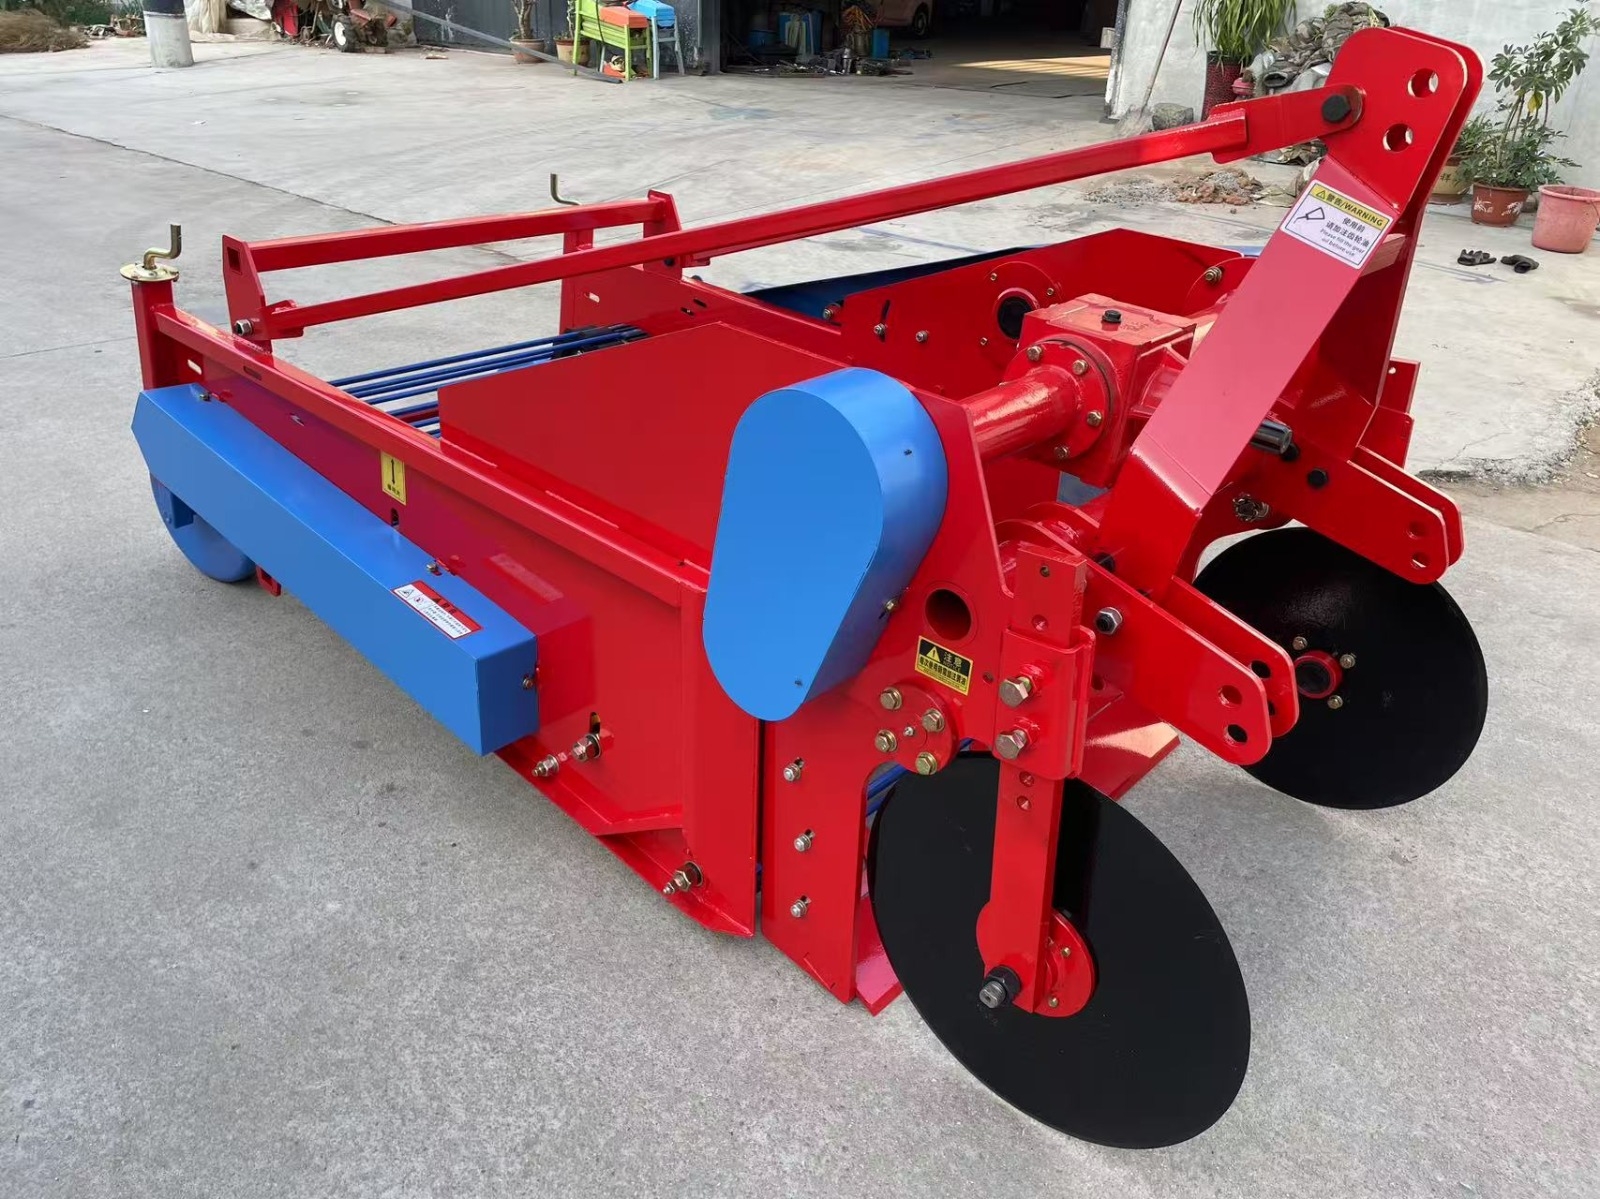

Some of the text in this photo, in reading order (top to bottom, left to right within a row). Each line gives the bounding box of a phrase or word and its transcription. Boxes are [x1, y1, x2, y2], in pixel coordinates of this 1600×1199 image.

[1326, 193, 1383, 226] 警告/WARNING
[1325, 221, 1370, 247] 请加注齿轮油
[1343, 217, 1365, 233] 使用前
[1320, 228, 1337, 240] Please
[1343, 239, 1352, 248] the
[1352, 244, 1365, 254] gear
[943, 651, 962, 668] 注意
